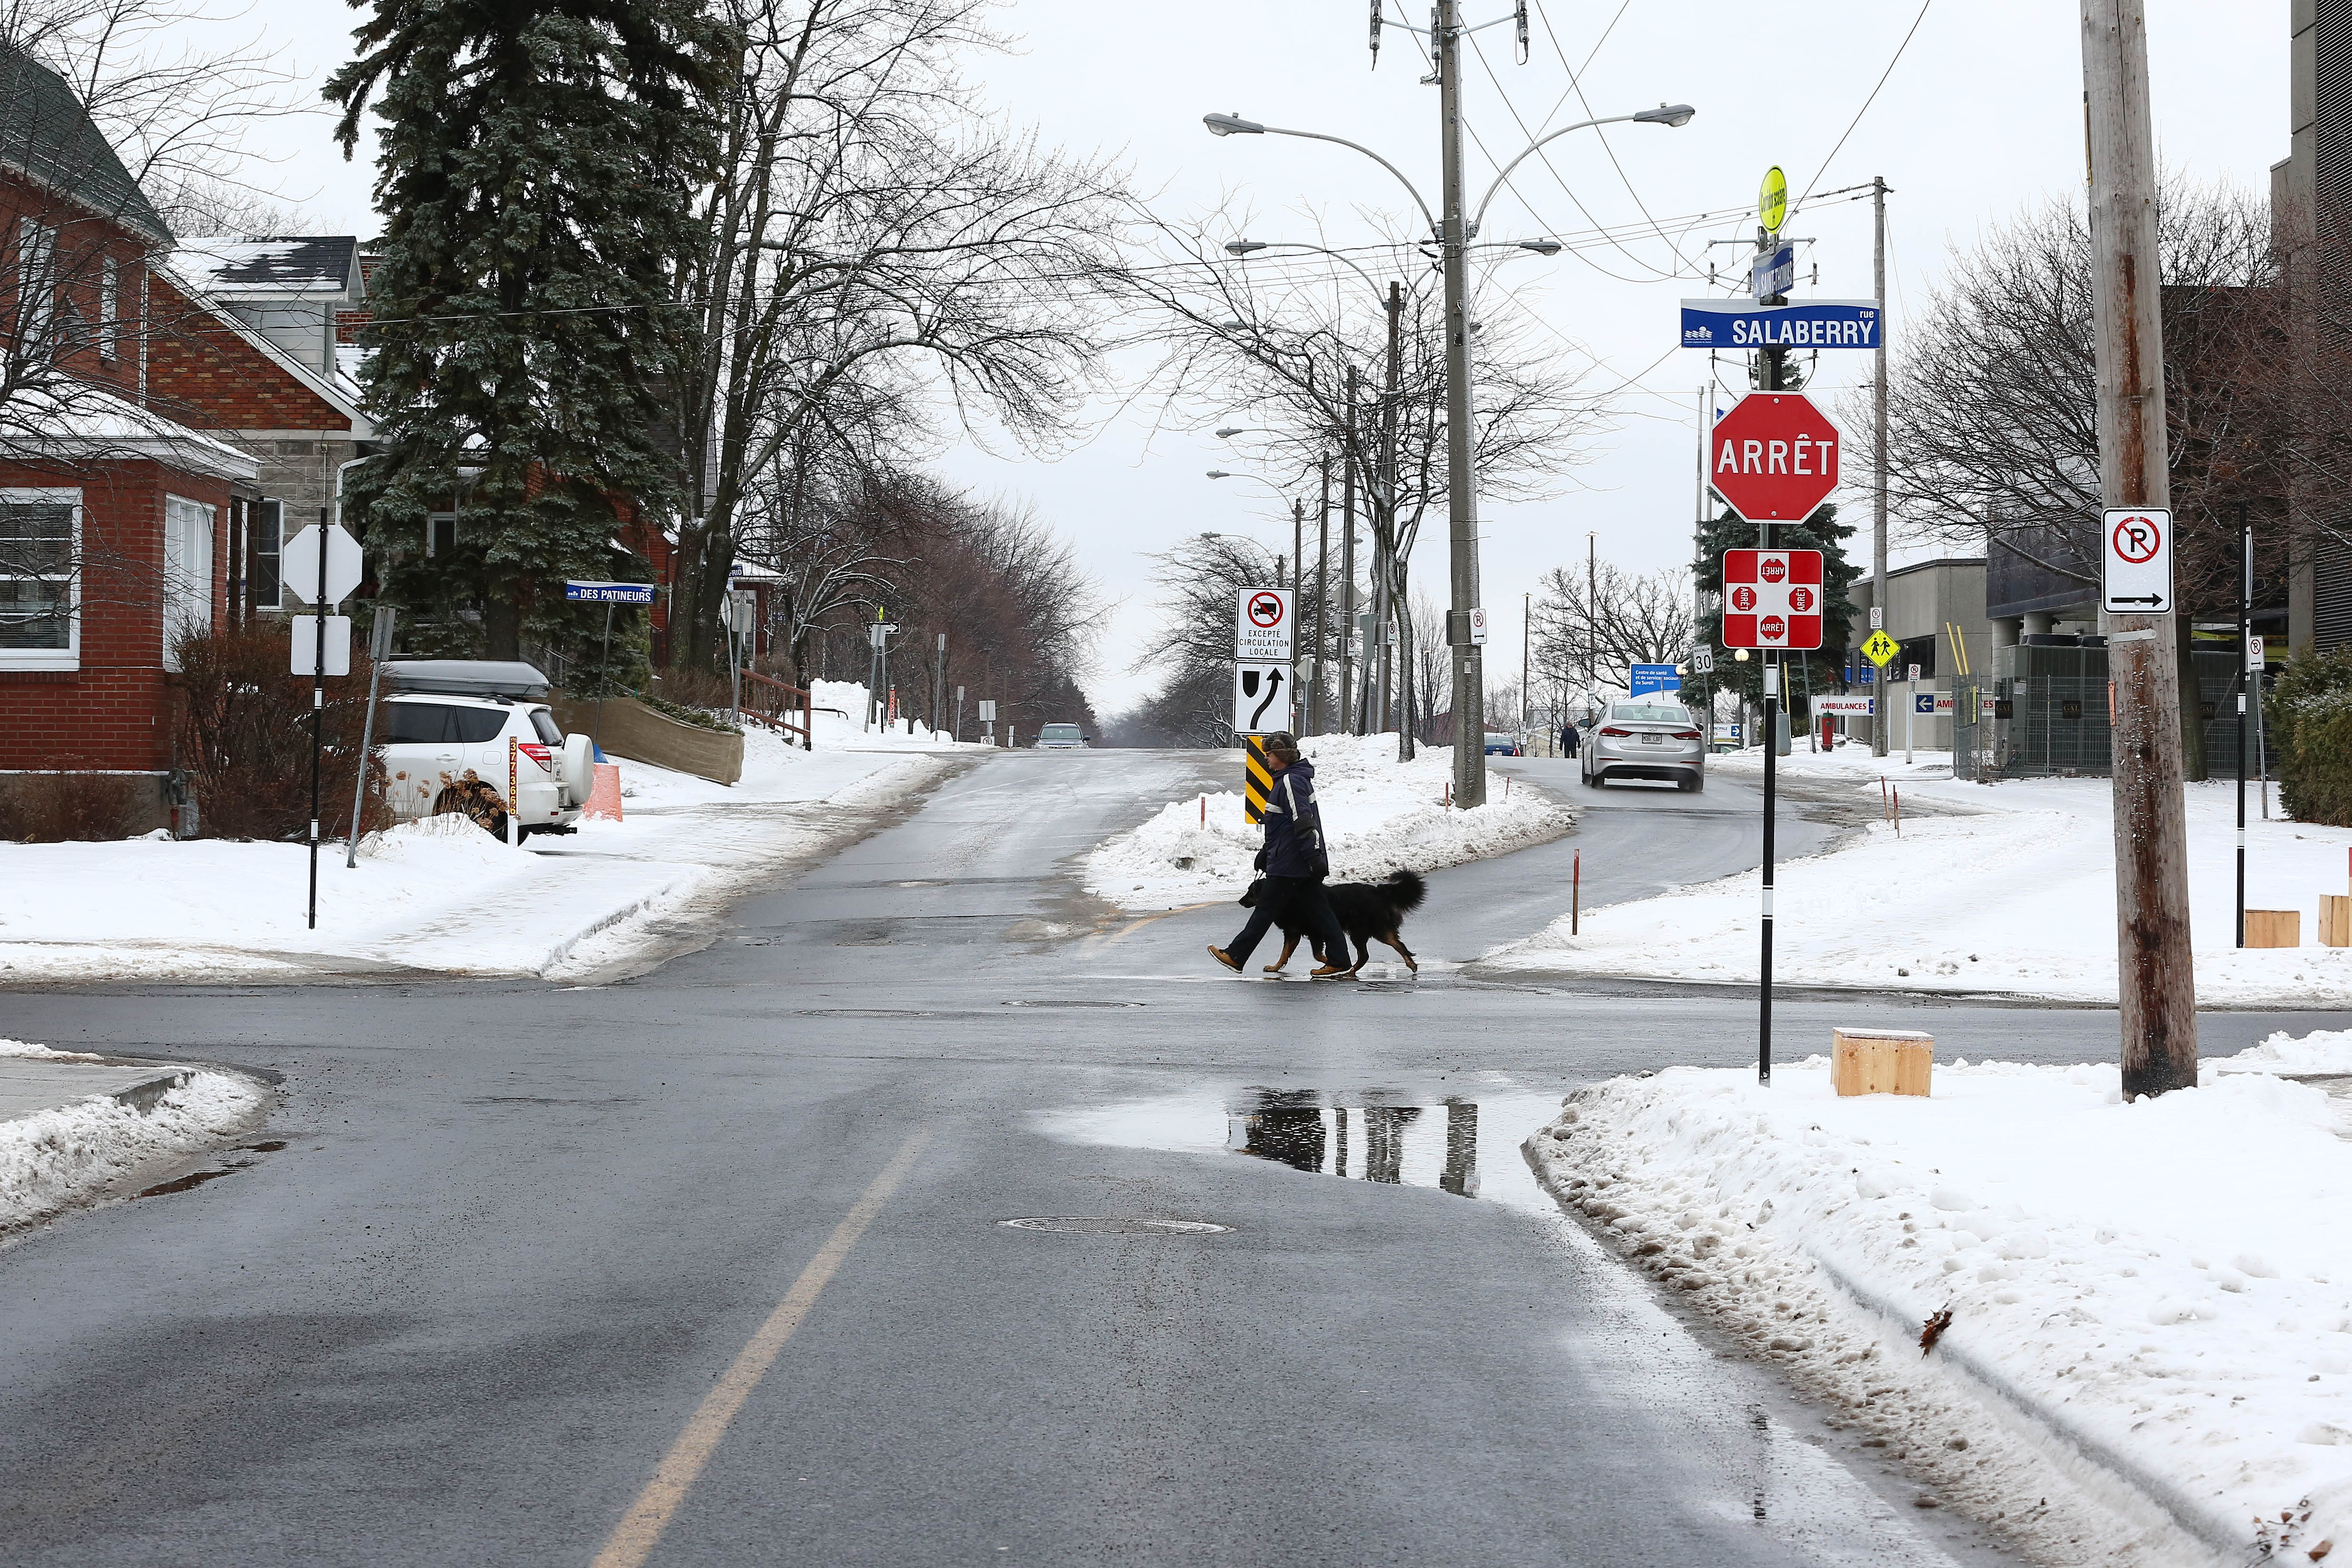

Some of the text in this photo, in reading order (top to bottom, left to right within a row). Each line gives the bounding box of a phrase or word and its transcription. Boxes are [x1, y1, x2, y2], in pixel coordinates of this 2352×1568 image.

[1761, 260, 1792, 297] SAINT-THOMAS
[1732, 319, 1874, 345] SALABERRY
[1717, 434, 1833, 475] ARRÊT
[1762, 567, 1784, 576] ARRÊT
[580, 589, 651, 602] DES PATINEURS
[1740, 587, 1750, 611] ARRÊT
[1795, 588, 1806, 611] ARRÊT
[1249, 629, 1280, 638] EXCEPTÉ
[1761, 622, 1784, 632] ARRÊT
[1239, 639, 1289, 647] CIRCULATION
[1696, 654, 1711, 670] 30
